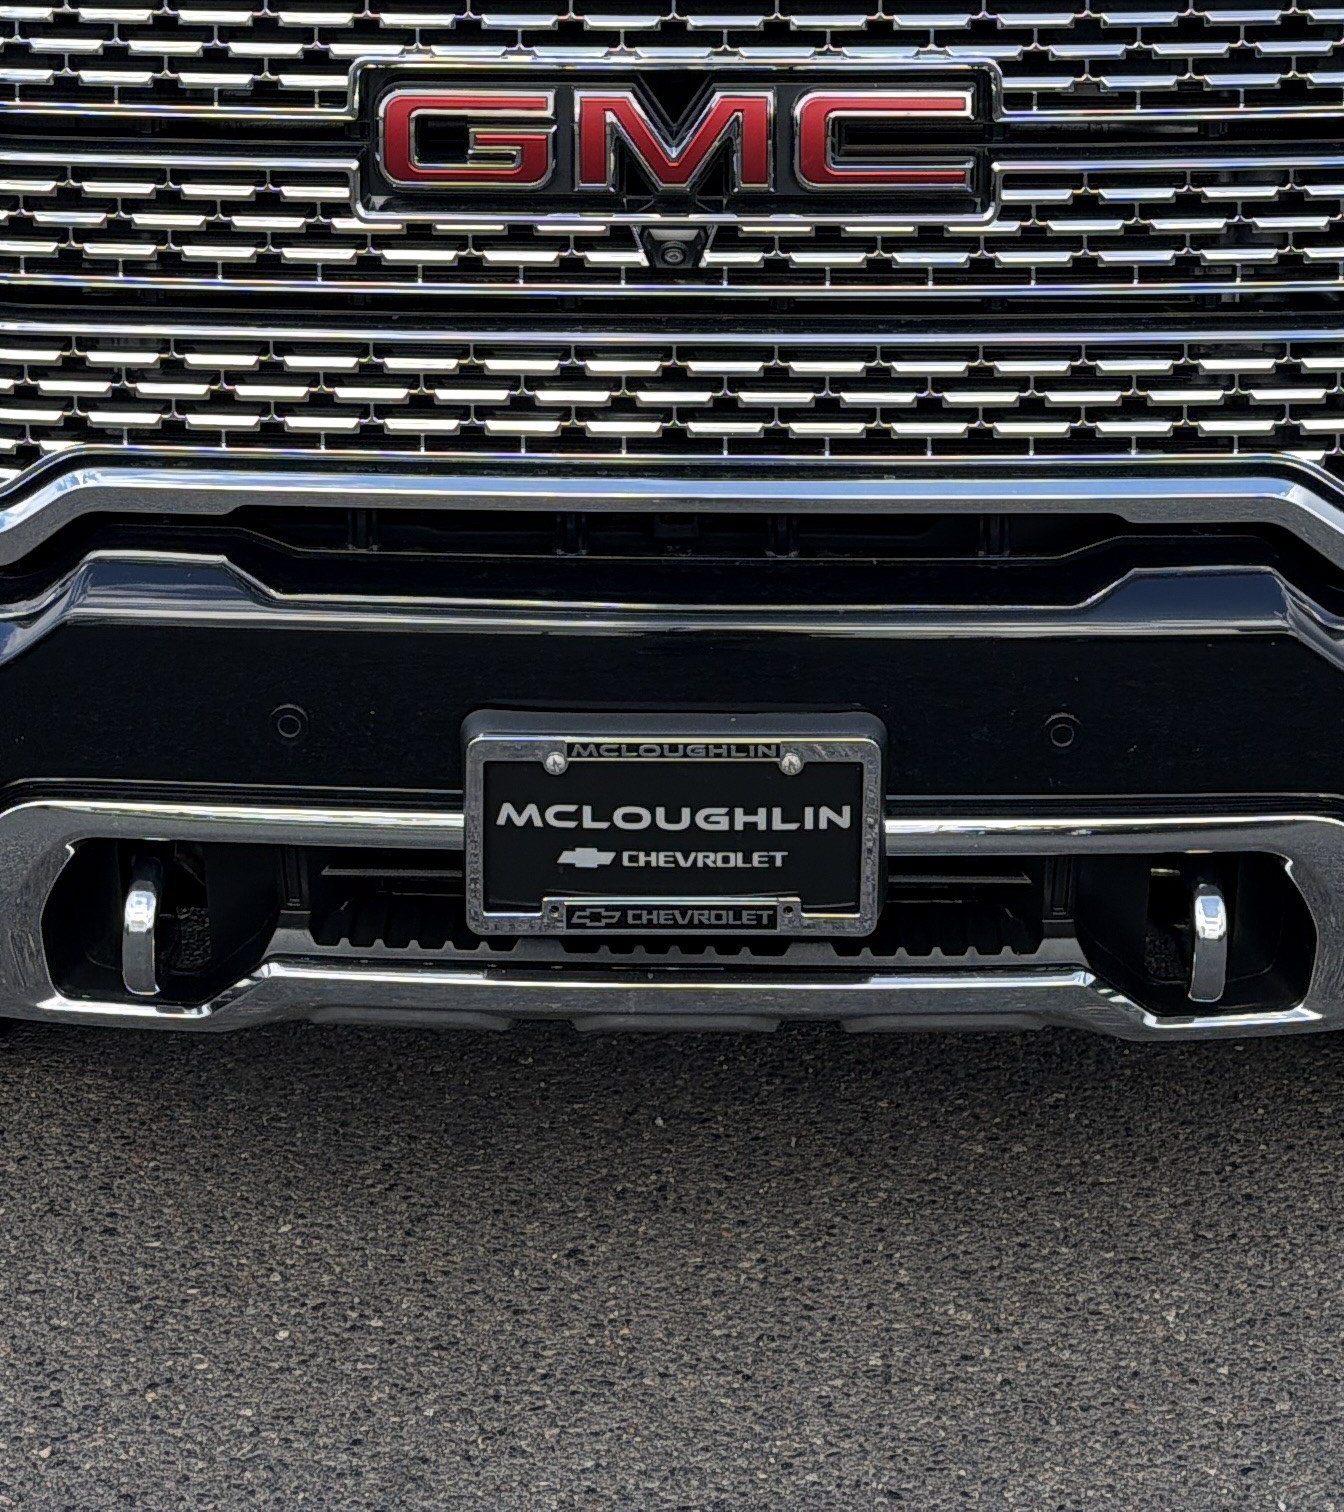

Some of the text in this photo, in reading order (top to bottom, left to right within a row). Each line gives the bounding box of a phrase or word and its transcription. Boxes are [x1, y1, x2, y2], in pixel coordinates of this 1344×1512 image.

[376, 87, 974, 191] GMC
[570, 743, 778, 758] MCLOUGHLIN
[495, 802, 852, 831] MCLOUGHLIN
[621, 850, 789, 869] CHEVROLET
[626, 908, 775, 926] CHEVROLET
